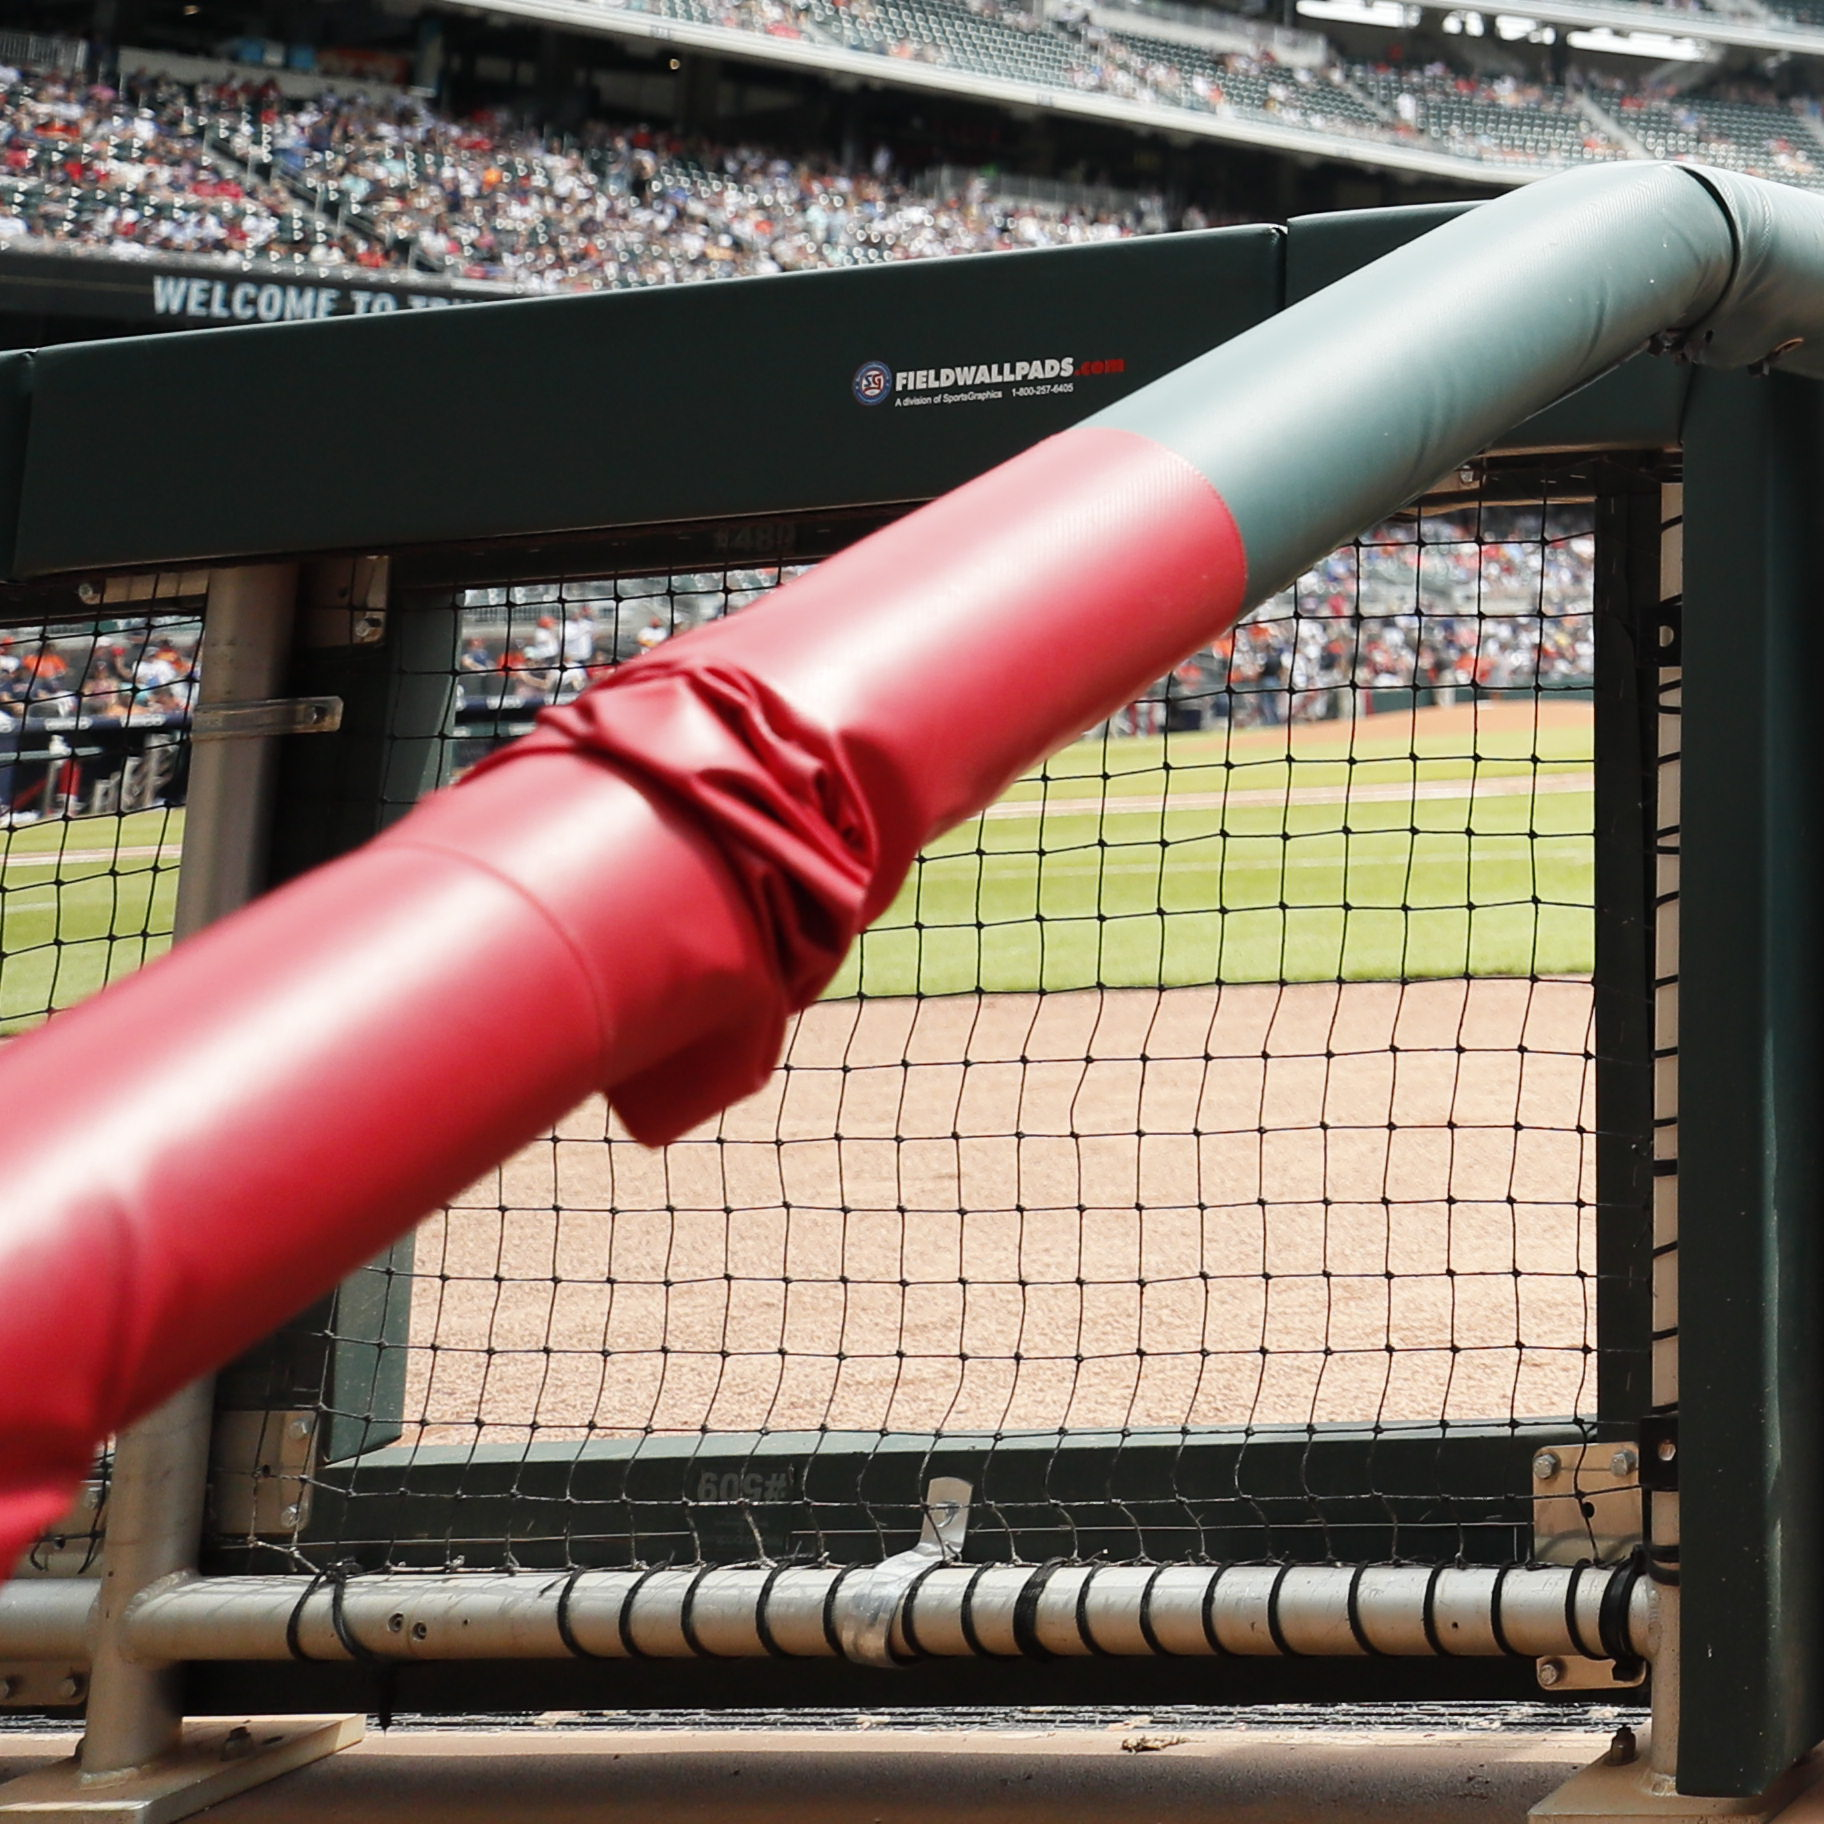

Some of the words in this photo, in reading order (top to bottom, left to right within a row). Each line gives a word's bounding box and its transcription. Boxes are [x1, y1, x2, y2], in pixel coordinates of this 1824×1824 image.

[153, 275, 341, 322] WELCOME
[895, 357, 1126, 392] FIELDWALLPADS.com
[894, 398, 903, 407] A
[903, 396, 932, 407] division
[933, 394, 942, 405] of
[943, 390, 1003, 405] SportsGraphics
[1011, 383, 1075, 398] 1-800-257-6405
